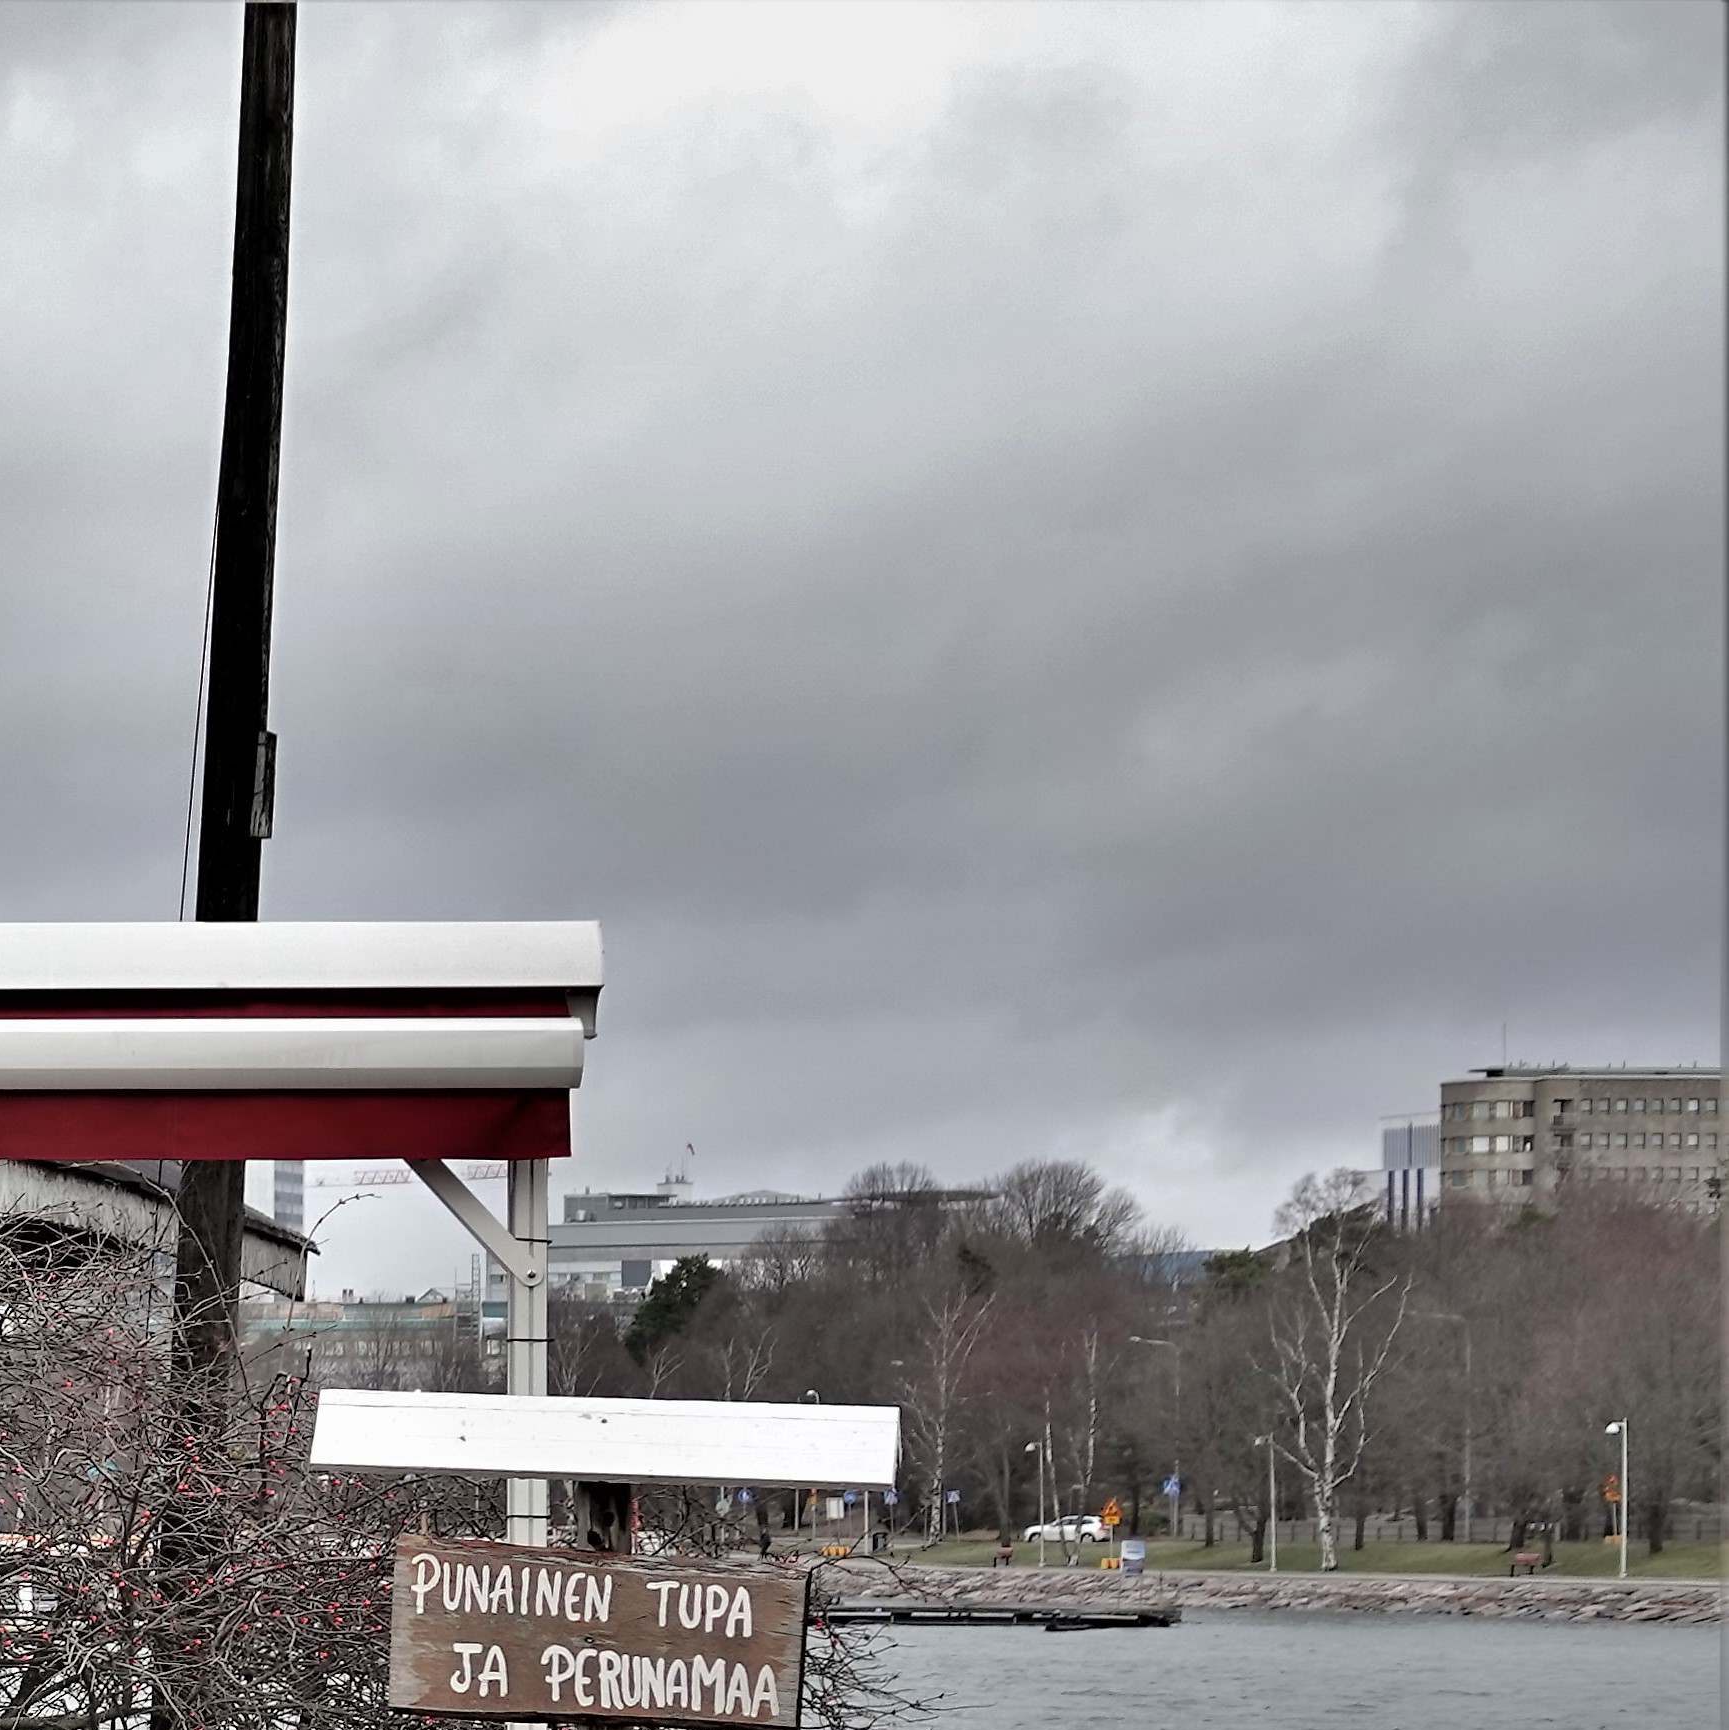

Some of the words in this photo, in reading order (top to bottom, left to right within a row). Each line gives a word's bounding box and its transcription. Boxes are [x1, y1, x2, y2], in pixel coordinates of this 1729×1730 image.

[410, 1552, 613, 1623] PUNAINEN
[646, 1579, 754, 1638] TUPA
[449, 1642, 509, 1698] JA
[540, 1644, 781, 1718] PERUNAMAA
